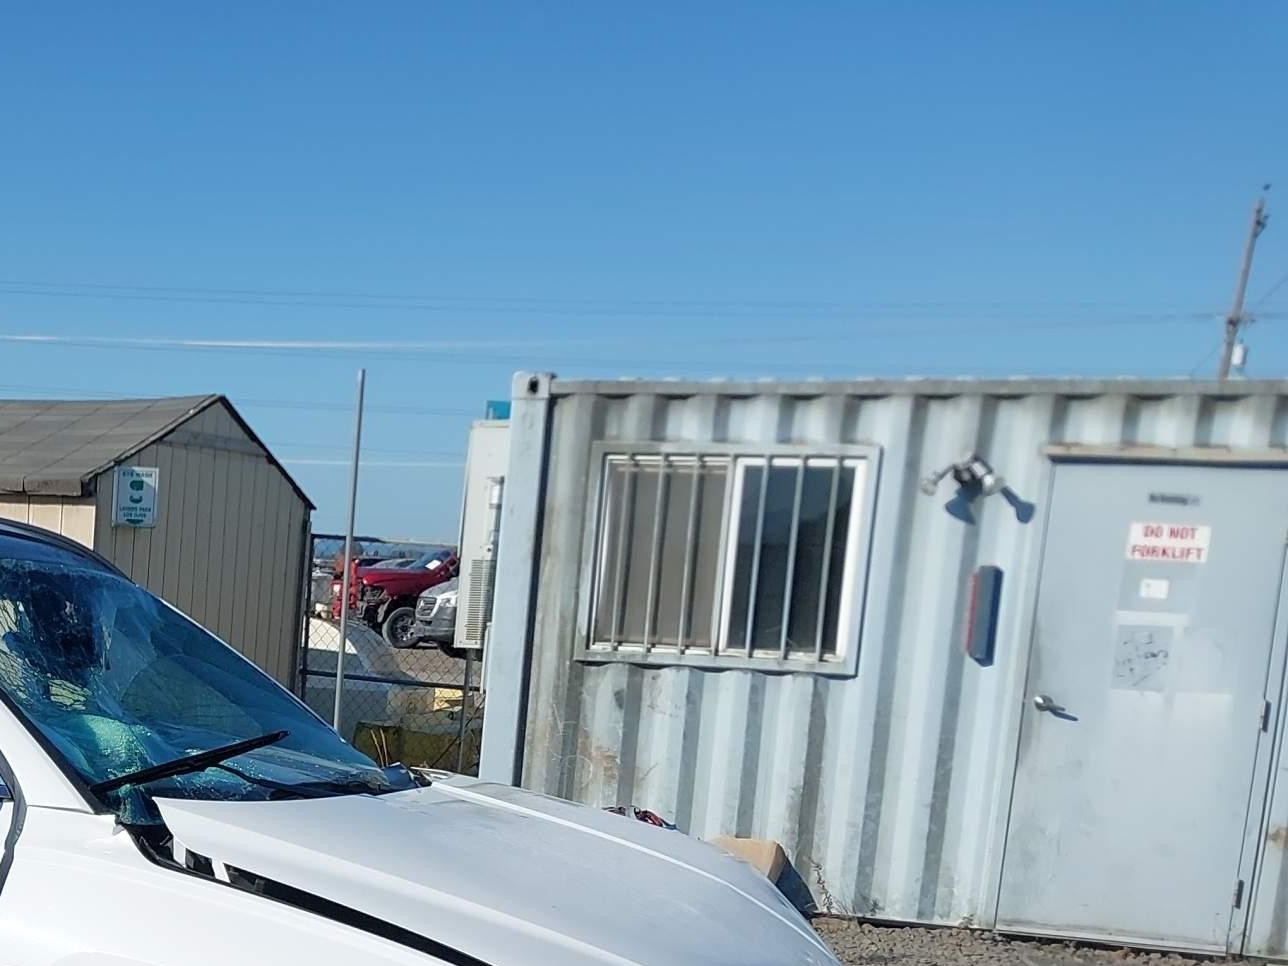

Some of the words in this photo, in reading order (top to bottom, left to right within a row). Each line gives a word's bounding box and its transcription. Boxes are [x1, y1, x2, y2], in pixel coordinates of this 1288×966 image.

[1143, 525, 1163, 538] DO
[1169, 527, 1199, 540] NOT
[1130, 544, 1206, 561] FORKLIFT
